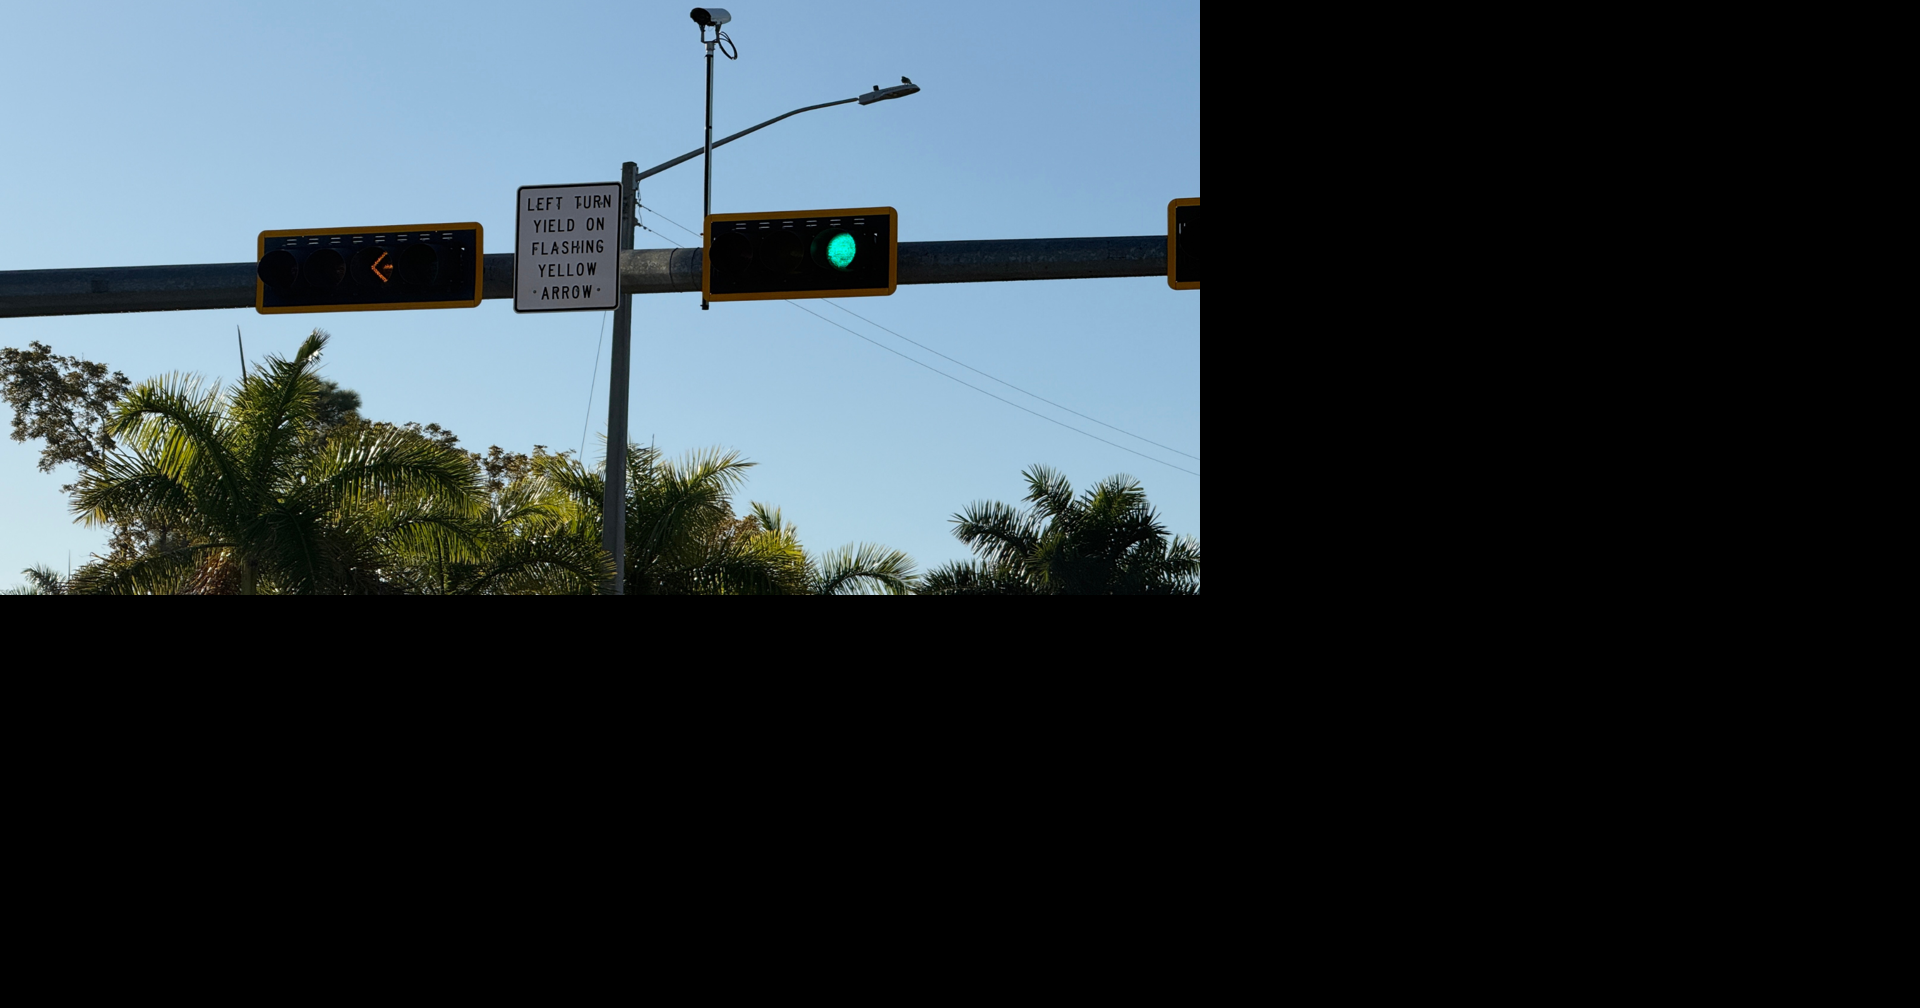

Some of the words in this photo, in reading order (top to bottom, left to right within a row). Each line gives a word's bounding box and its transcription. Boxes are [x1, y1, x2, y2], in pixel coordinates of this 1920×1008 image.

[527, 196, 563, 211] LEFT
[574, 194, 611, 209] TURN
[533, 218, 575, 233] YIELD
[586, 217, 605, 231] ON
[531, 239, 604, 255] FLASHING
[538, 262, 597, 277] YELLOW
[541, 284, 592, 300] ARROW
